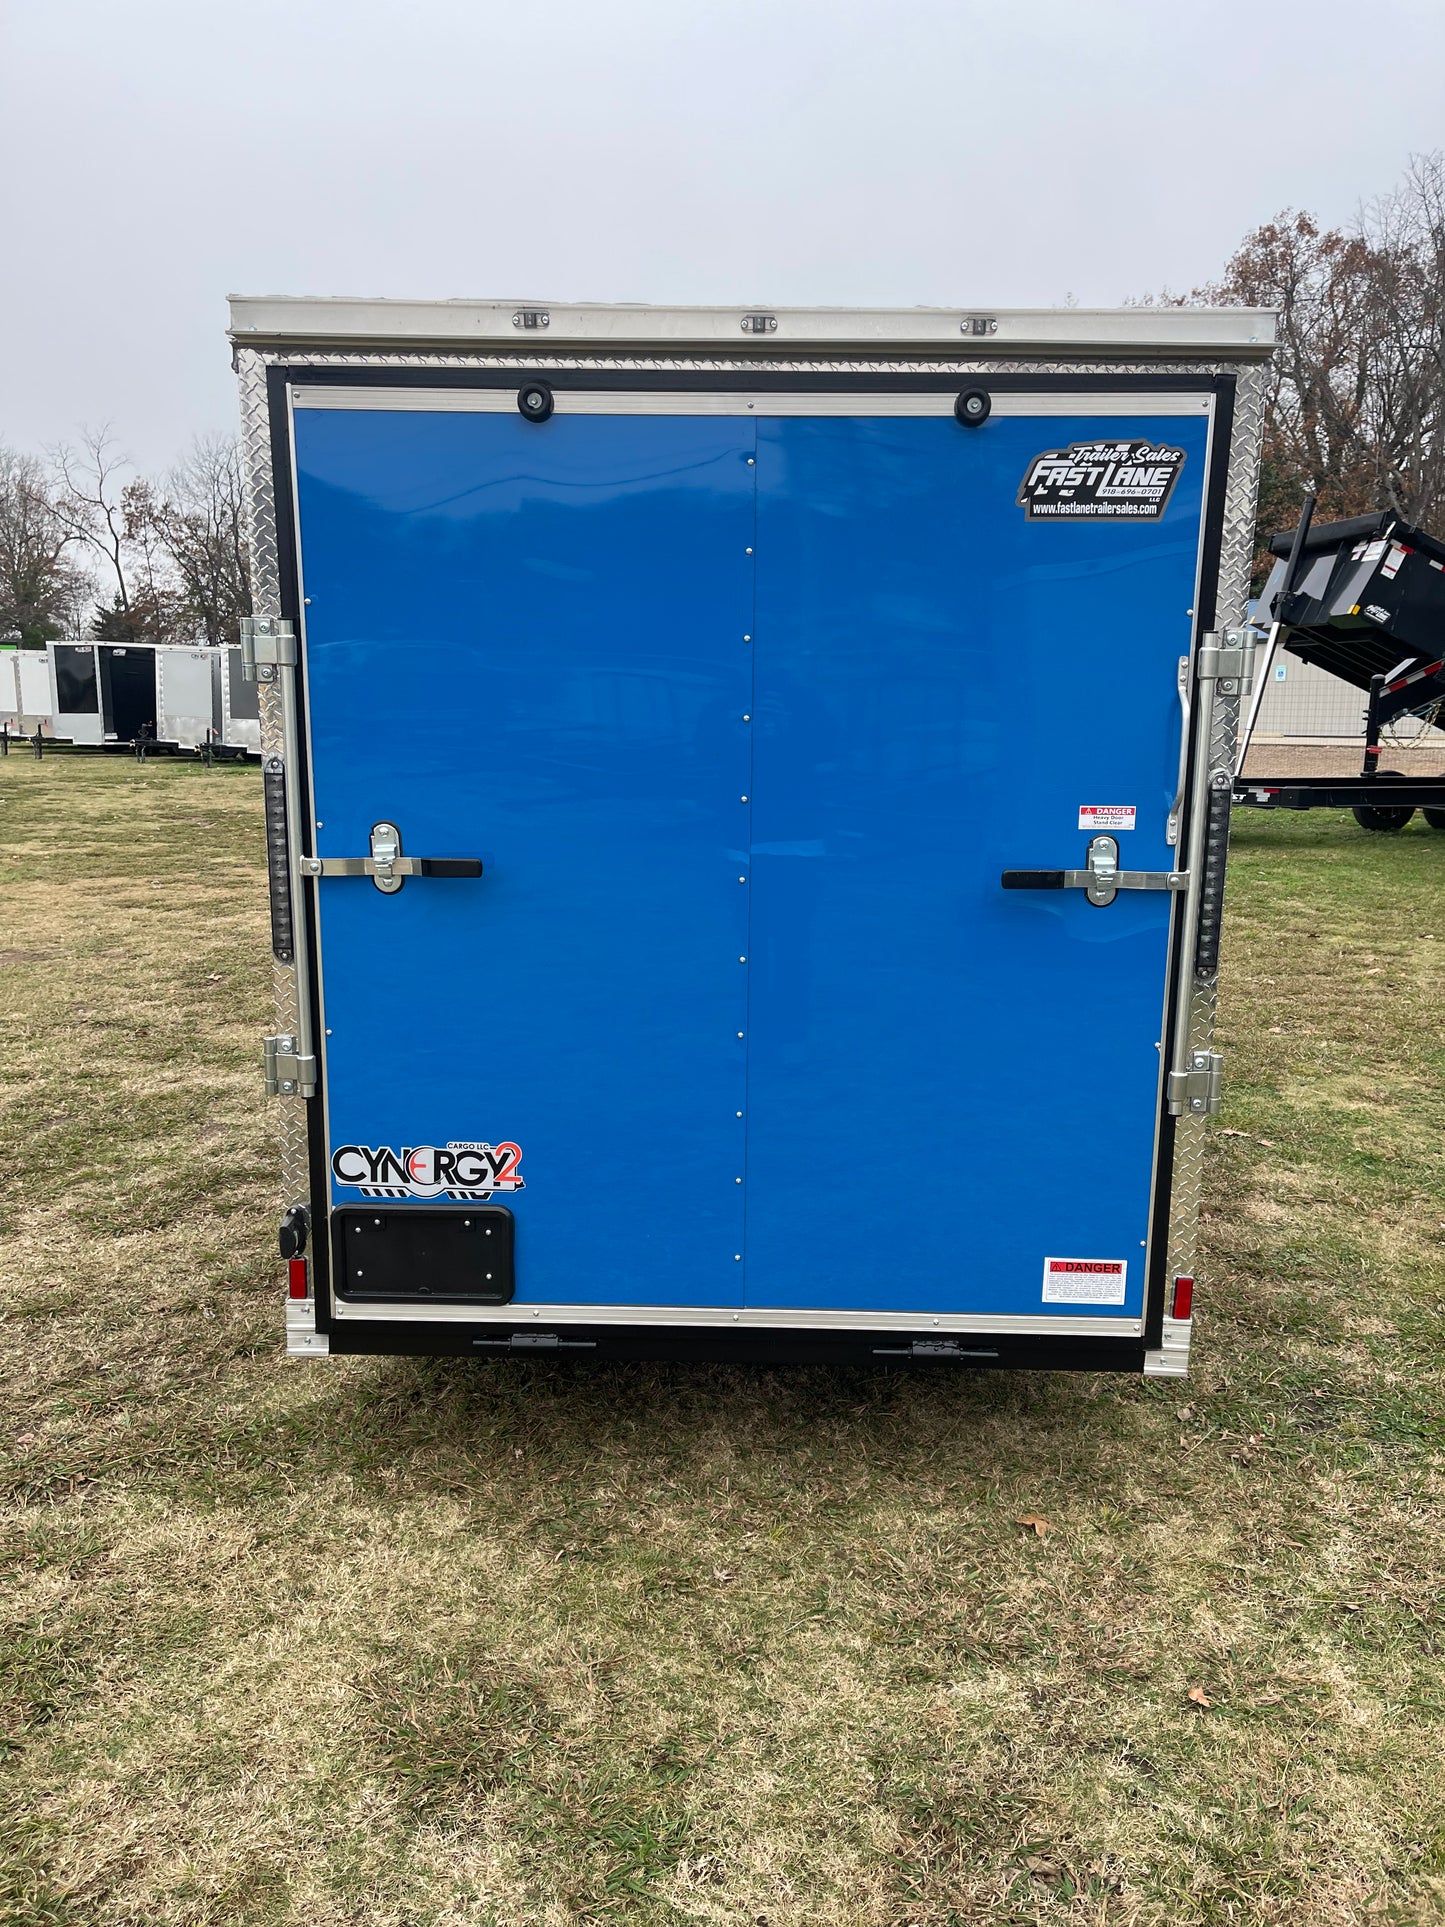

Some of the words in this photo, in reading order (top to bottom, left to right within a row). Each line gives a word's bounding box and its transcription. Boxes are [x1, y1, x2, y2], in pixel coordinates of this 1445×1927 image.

[1073, 446, 1131, 464] Trailer
[1133, 446, 1180, 464] Sales
[1028, 459, 1104, 486] FAST
[1096, 463, 1174, 490] LANE
[1033, 502, 1157, 515] www.fastlanetrailersales.com
[447, 1142, 476, 1150] CARGO
[1065, 1262, 1121, 1274] DANGER
